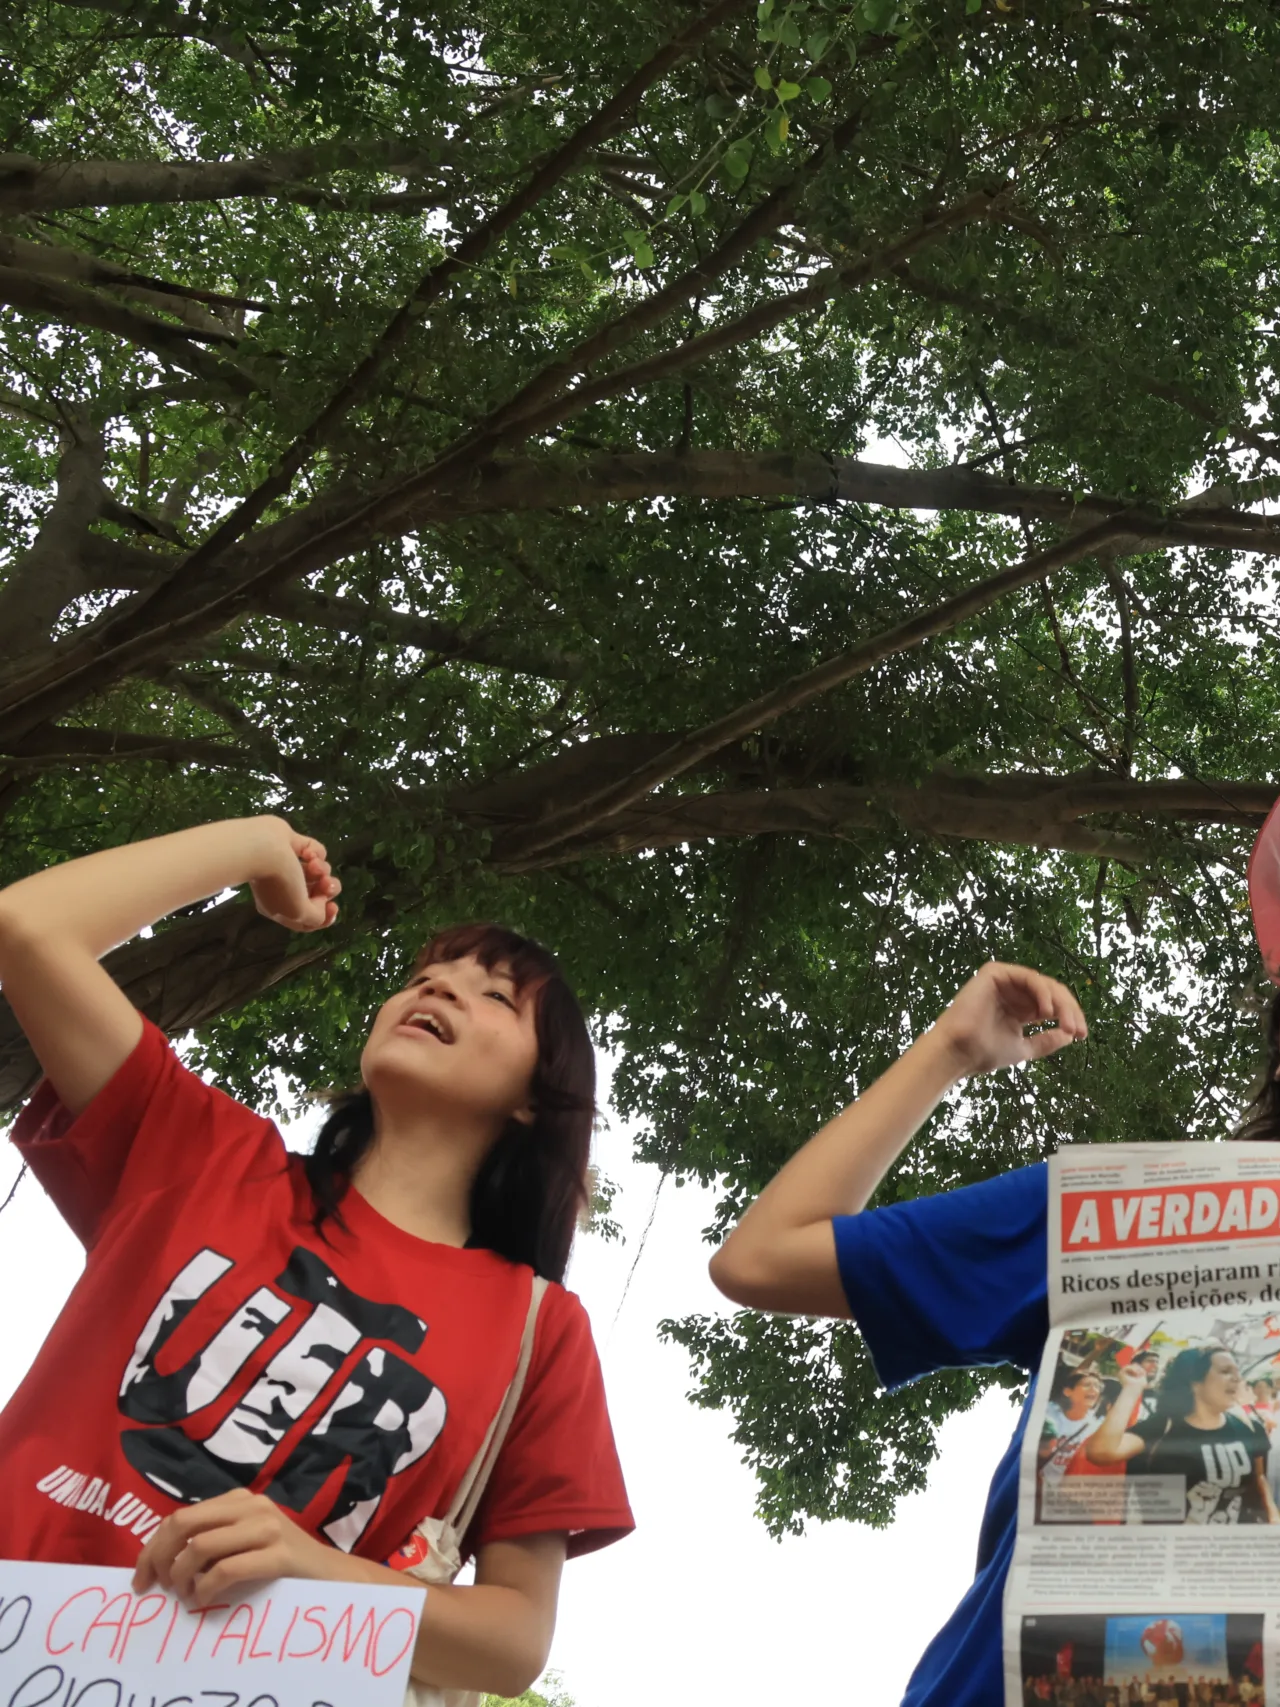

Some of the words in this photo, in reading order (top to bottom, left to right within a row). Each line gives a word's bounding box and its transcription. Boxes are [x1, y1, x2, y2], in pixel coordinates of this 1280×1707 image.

[1067, 1199, 1101, 1244] A
[1060, 1273, 1121, 1294] Ricos
[1126, 1262, 1261, 1292] despejaram
[1111, 1297, 1149, 1315] nas
[1155, 1288, 1253, 1312] eleições,
[45, 1586, 416, 1677] CAPITALISMO
